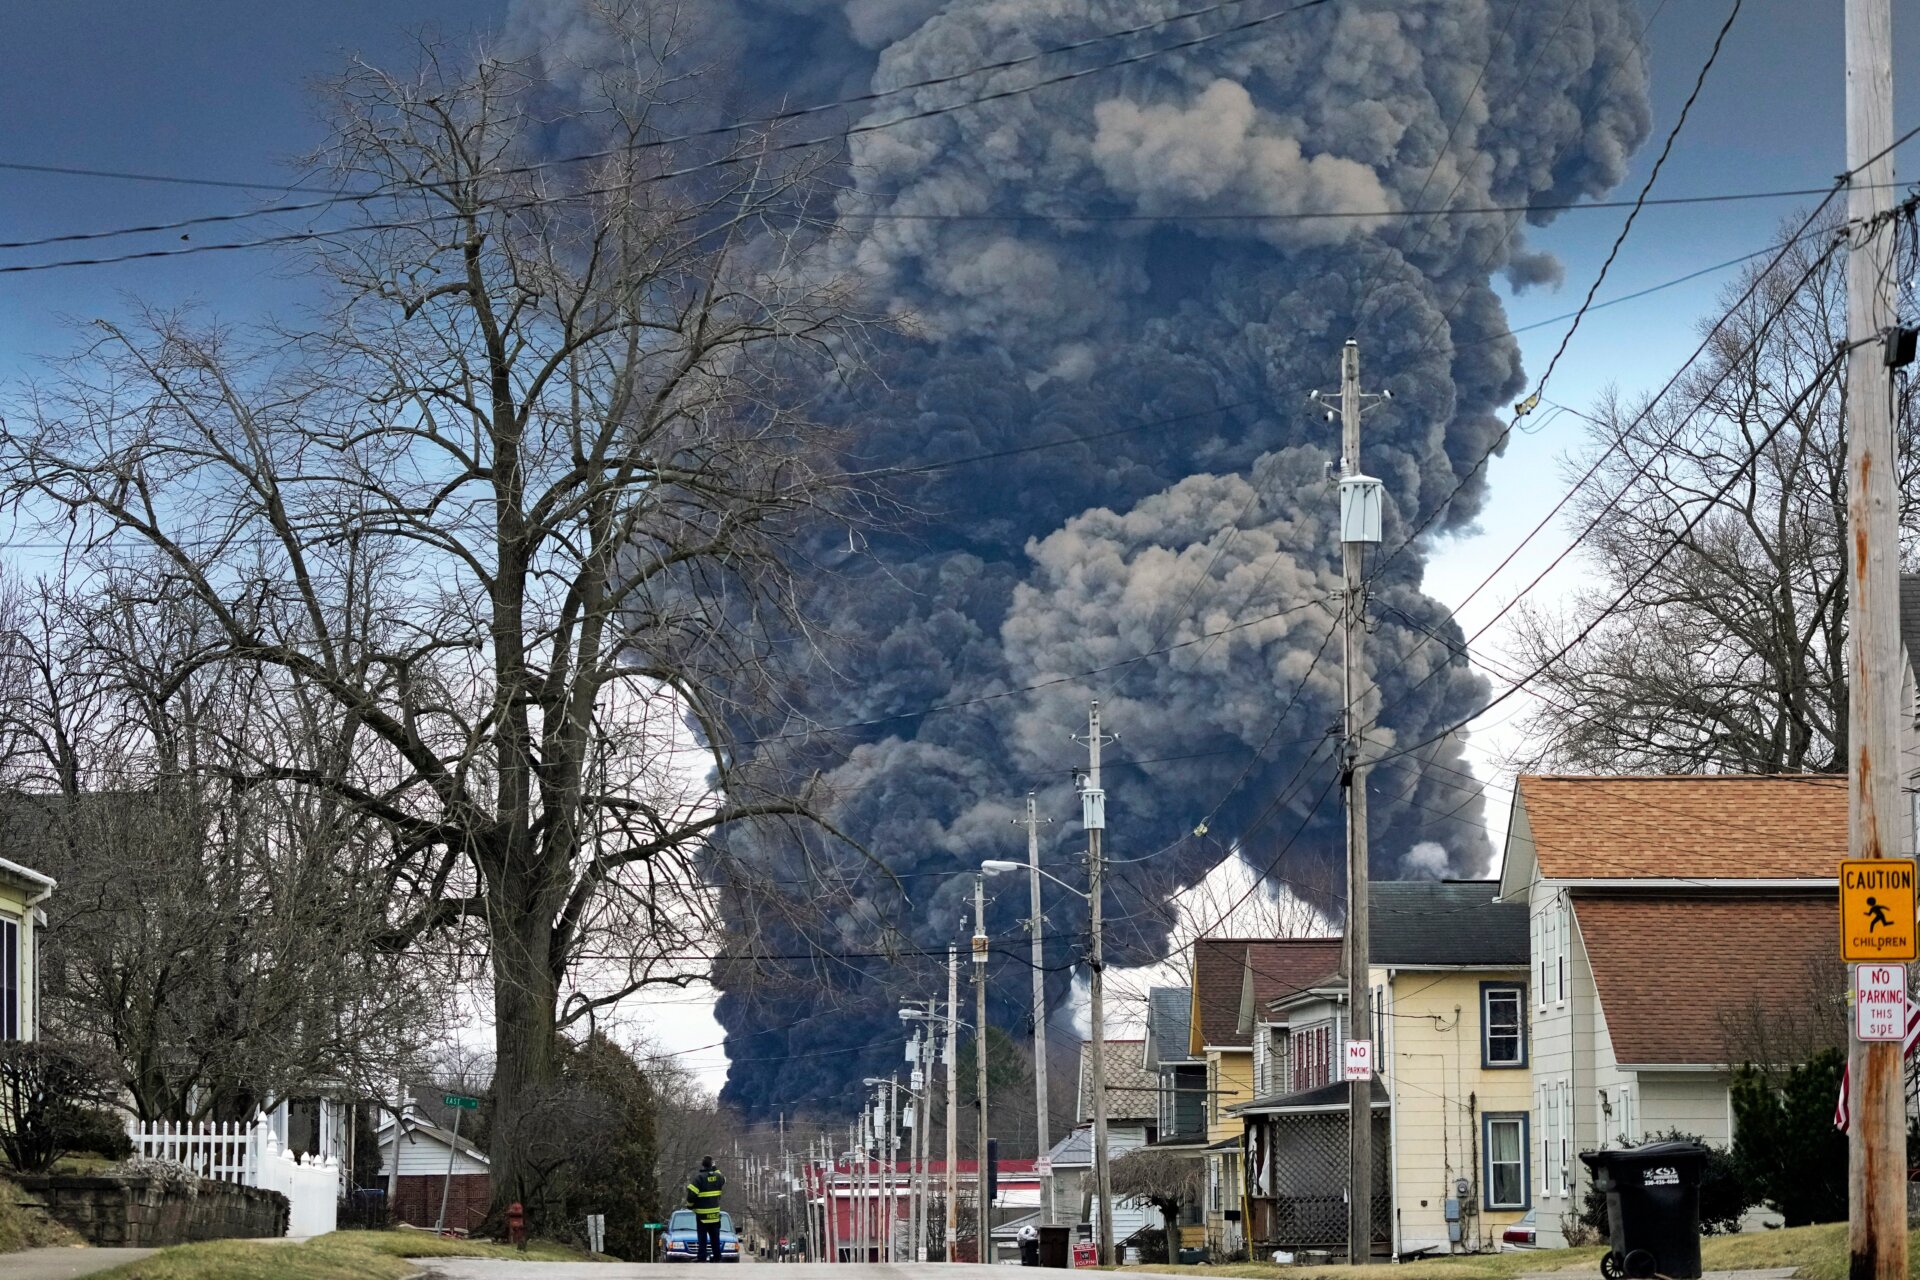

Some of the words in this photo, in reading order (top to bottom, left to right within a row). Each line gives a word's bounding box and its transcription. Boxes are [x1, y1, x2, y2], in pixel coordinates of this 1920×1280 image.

[1846, 870, 1910, 889] CAUTION
[1853, 937, 1906, 947] CHILDREN
[1872, 970, 1890, 984] NO
[1860, 990, 1902, 1003] PARKING
[1871, 1009, 1893, 1019] THIS
[1870, 1024, 1893, 1034] SIDE
[1350, 1047, 1366, 1057] NO
[445, 1097, 460, 1105] EAST
